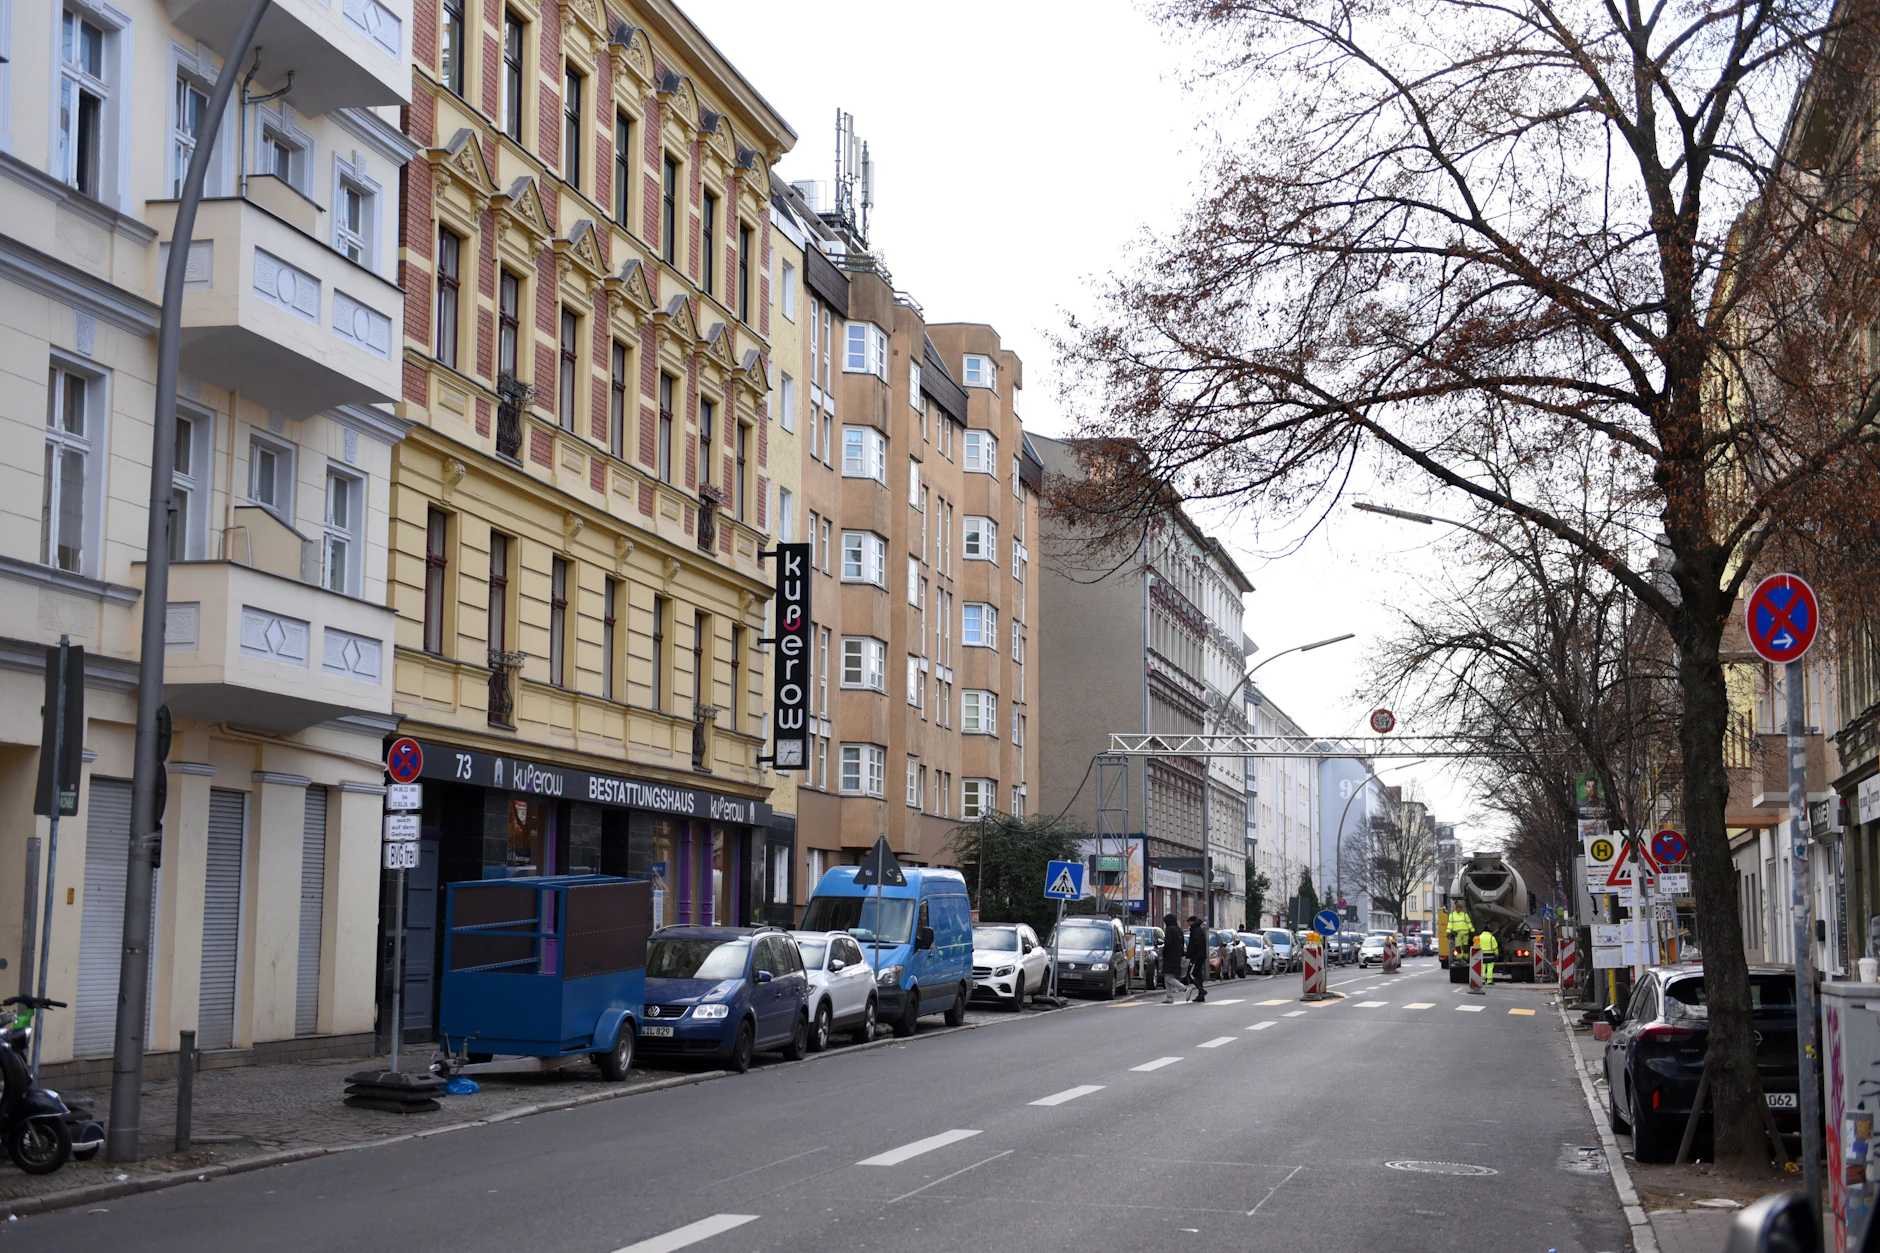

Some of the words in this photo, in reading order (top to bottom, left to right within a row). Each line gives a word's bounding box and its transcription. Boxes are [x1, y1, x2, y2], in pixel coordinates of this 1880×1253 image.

[455, 754, 472, 779] 73
[589, 776, 695, 814] BESTATTUNGSHAUS
[1339, 779, 1367, 799] 97
[391, 845, 403, 865] BVG
[405, 844, 415, 865] frei
[1655, 906, 1665, 919] BVG
[646, 1027, 655, 1035] IL
[656, 1027, 670, 1036] 829
[1768, 1094, 1792, 1107] 062
